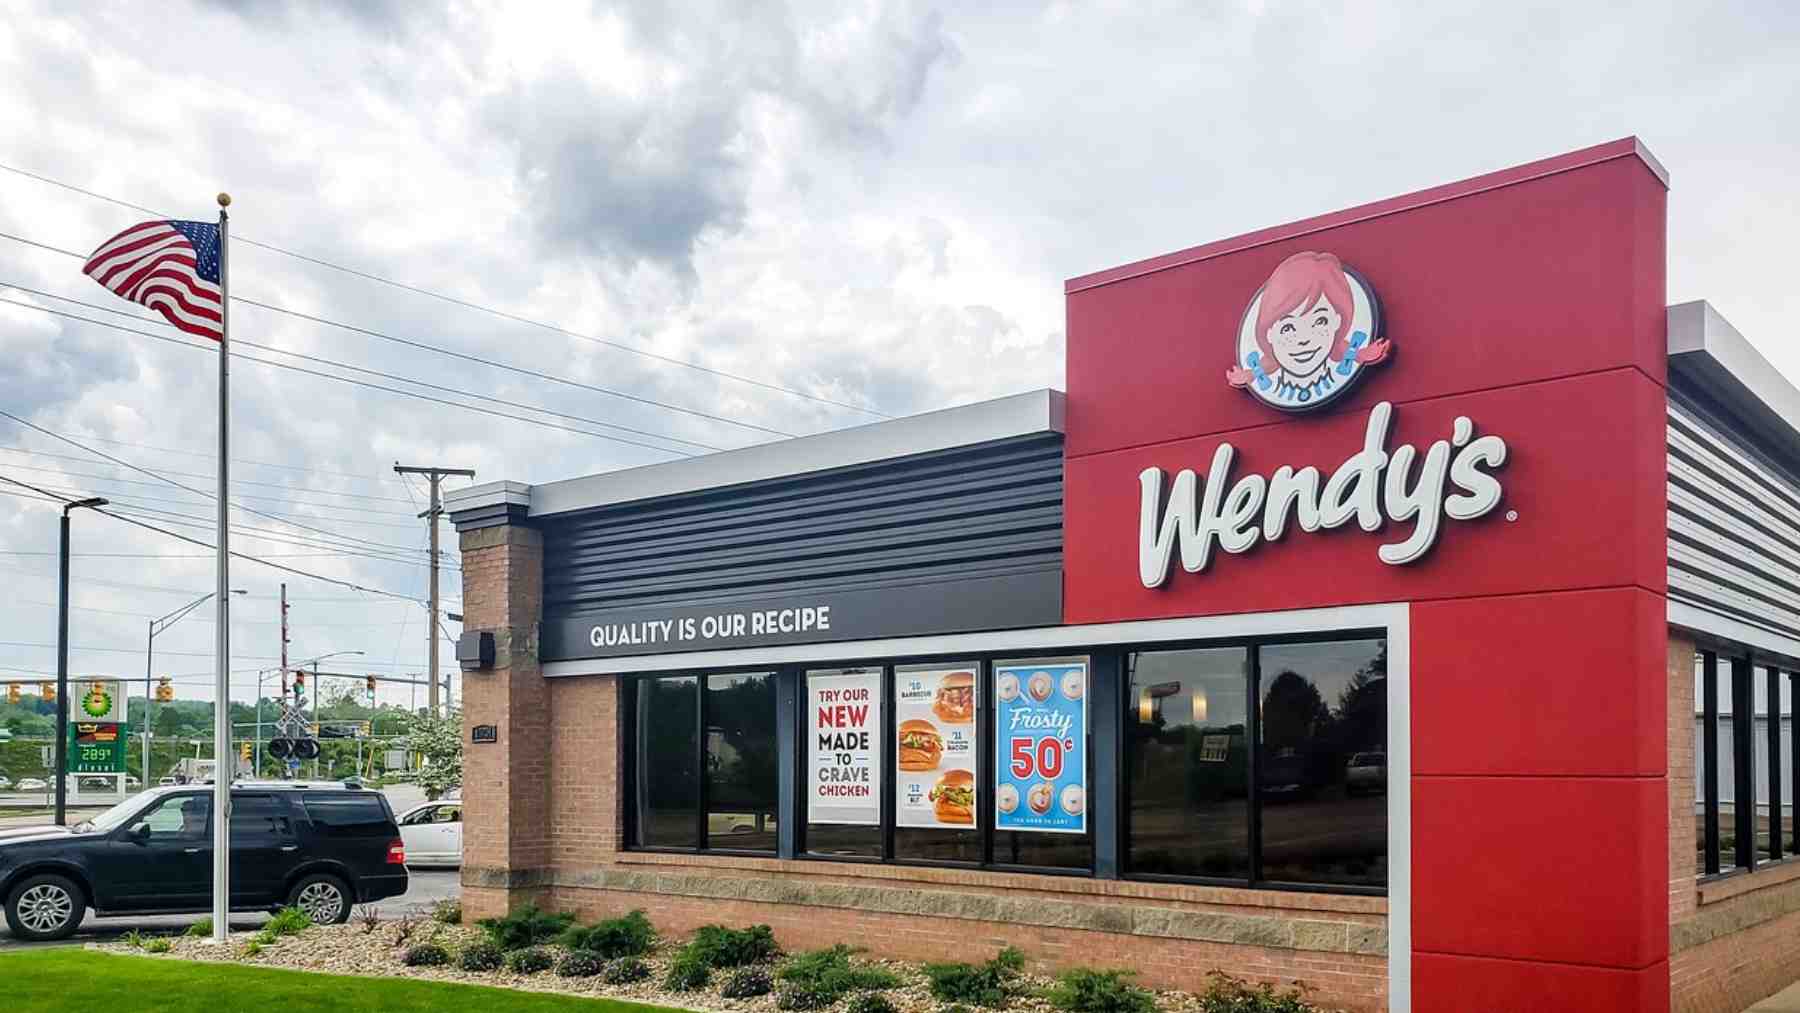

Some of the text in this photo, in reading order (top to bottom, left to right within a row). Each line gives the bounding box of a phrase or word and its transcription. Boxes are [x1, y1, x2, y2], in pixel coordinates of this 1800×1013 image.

[1139, 401, 1508, 589] Wendy's
[590, 606, 830, 647] QUALITY IS OUR RECIPE
[819, 689, 868, 702] TRY OUR
[818, 705, 868, 728] NEW
[1009, 706, 1073, 739] Frosty
[818, 732, 869, 751] MADE
[835, 753, 852, 766] TO
[818, 767, 869, 782] CRAVE
[818, 784, 869, 797] CHICKEN
